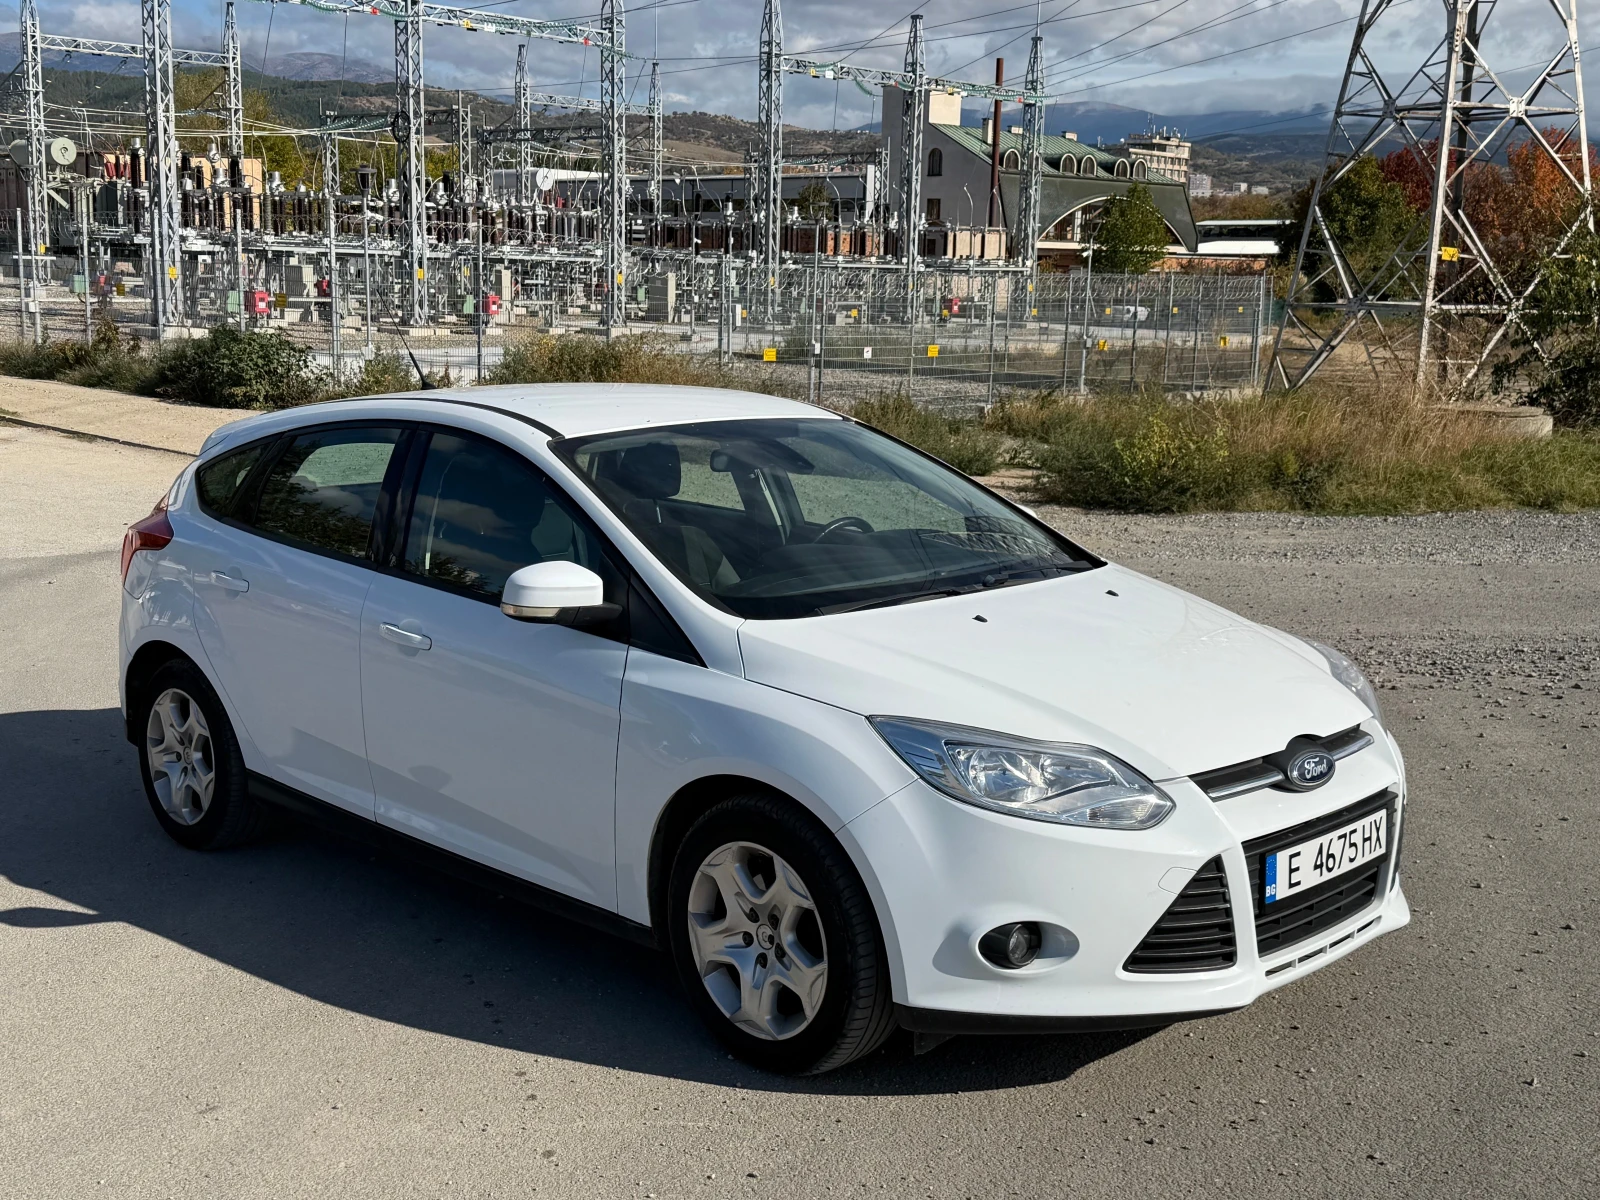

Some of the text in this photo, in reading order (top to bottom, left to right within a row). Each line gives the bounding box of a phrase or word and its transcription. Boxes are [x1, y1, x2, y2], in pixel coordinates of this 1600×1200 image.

[1304, 757, 1328, 779] Ford
[1288, 850, 1302, 890] E
[1265, 884, 1276, 897] BG
